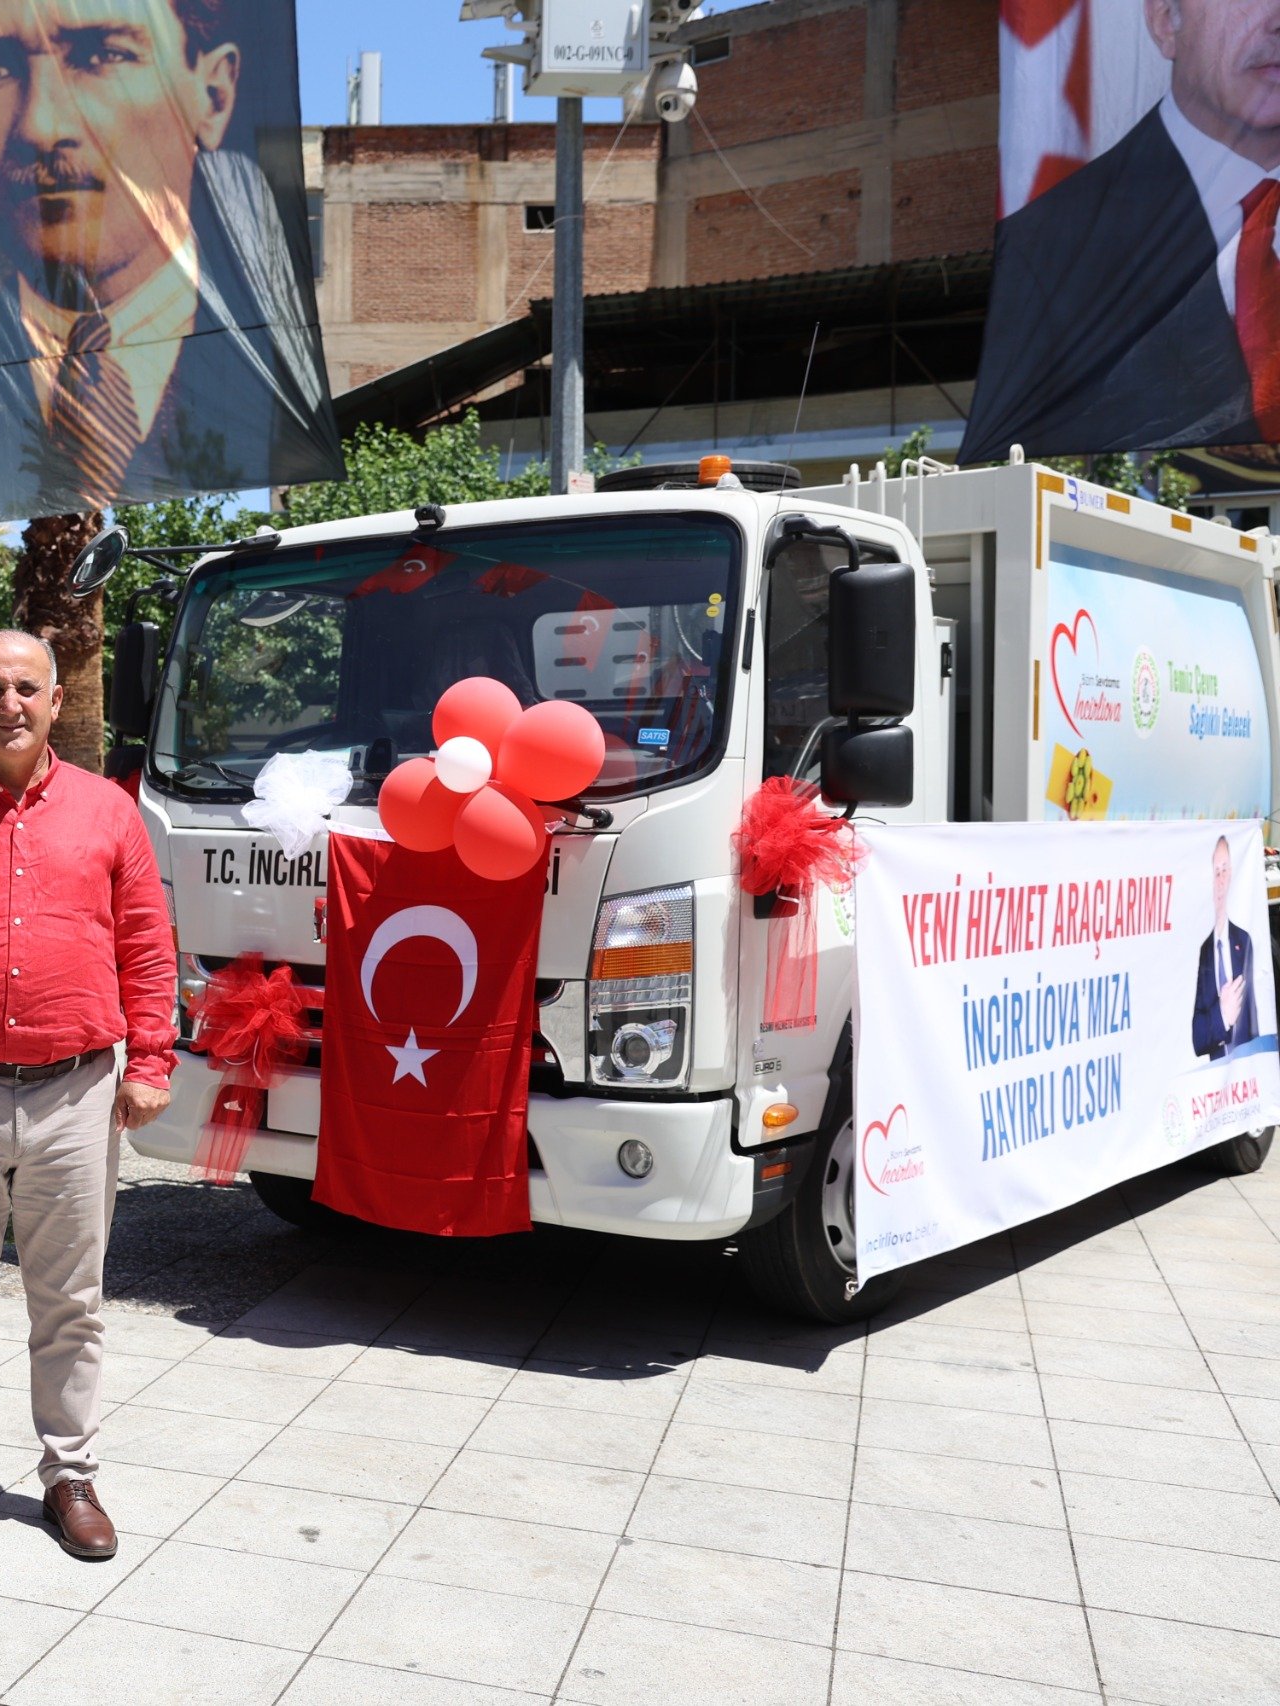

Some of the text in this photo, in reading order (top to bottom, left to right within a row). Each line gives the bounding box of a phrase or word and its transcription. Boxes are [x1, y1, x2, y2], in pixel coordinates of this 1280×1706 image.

[1167, 660, 1193, 694] Temiz
[1222, 706, 1251, 738] Gelecek
[203, 848, 241, 884] T.C.
[902, 872, 1173, 968] YENİ HİZMET ARAÇLARIMIZ
[963, 972, 1131, 1071] İNCİRLİOVA'MIZA
[755, 1061, 775, 1073] EURO
[980, 1071, 1055, 1162] HAYIRLI
[1062, 1052, 1121, 1130] OLSUN
